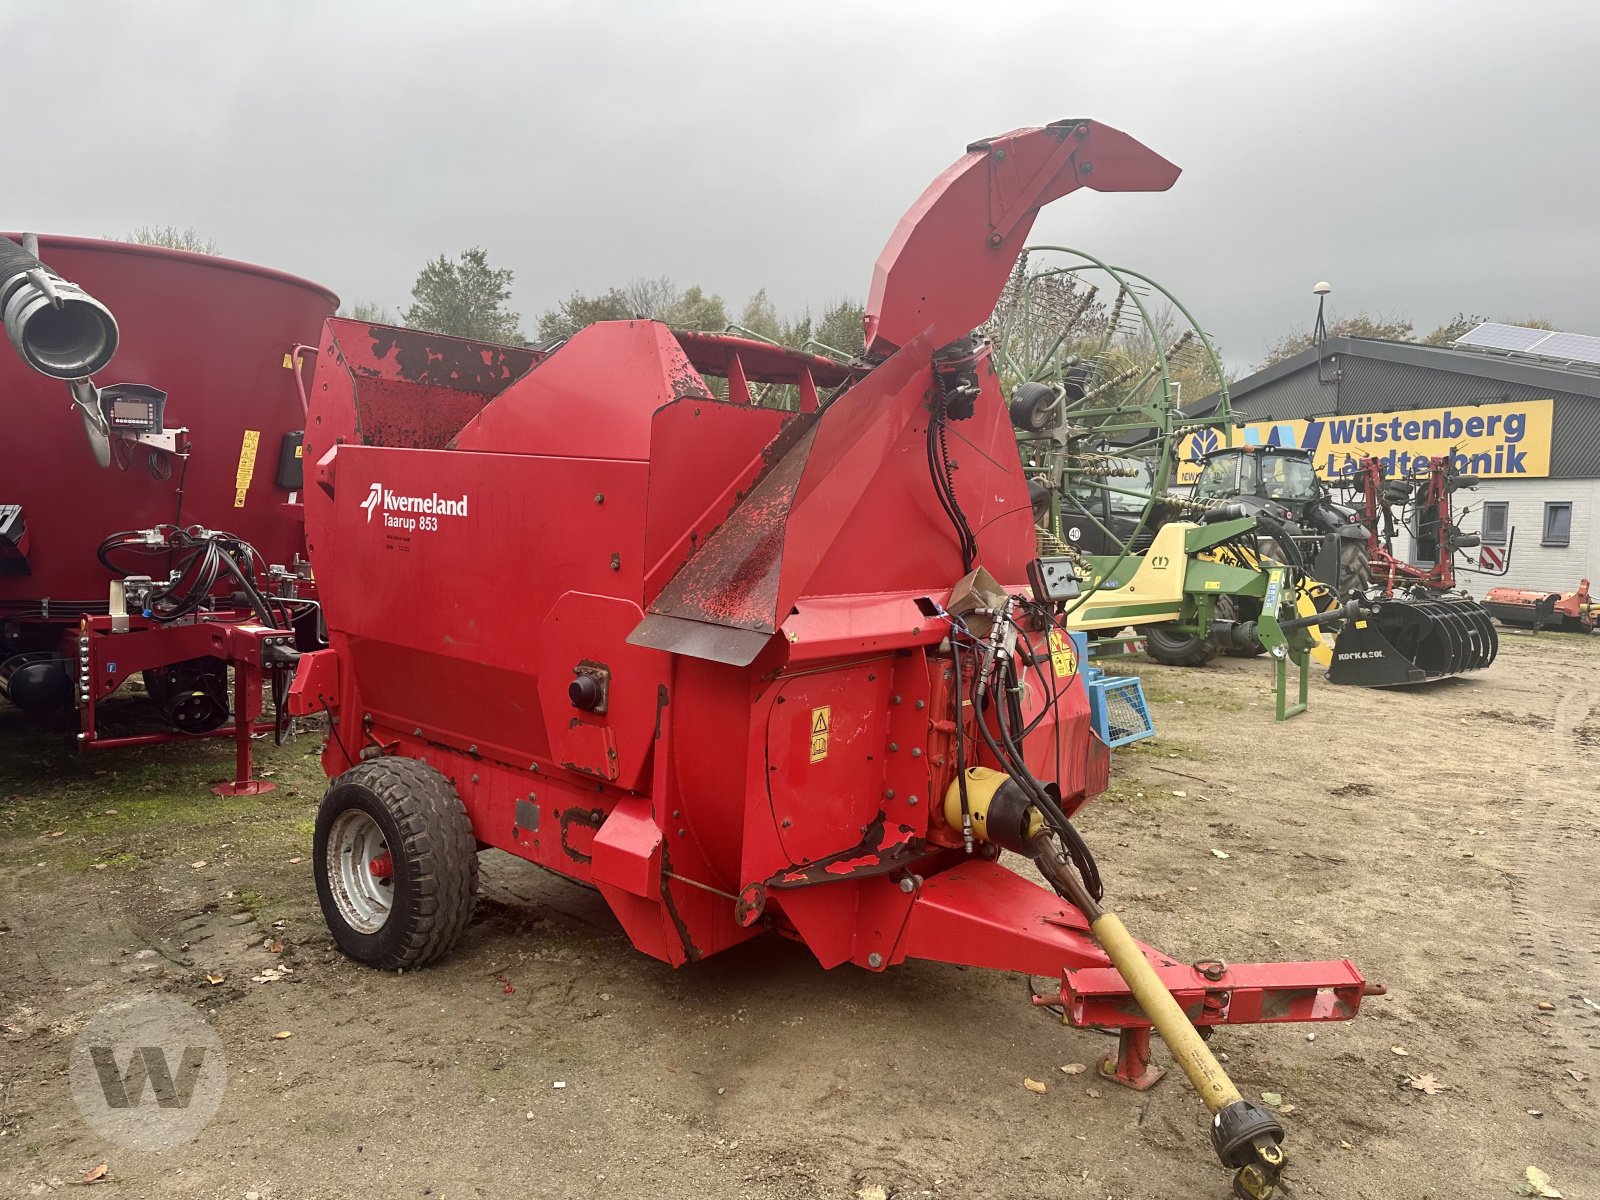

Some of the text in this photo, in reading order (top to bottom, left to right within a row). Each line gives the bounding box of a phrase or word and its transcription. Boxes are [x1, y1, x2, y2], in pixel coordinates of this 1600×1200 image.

[1329, 411, 1527, 443] Wüstenberg
[383, 489, 468, 517] Kverneland
[383, 513, 438, 532] Taarup 853
[1069, 528, 1080, 539] 40
